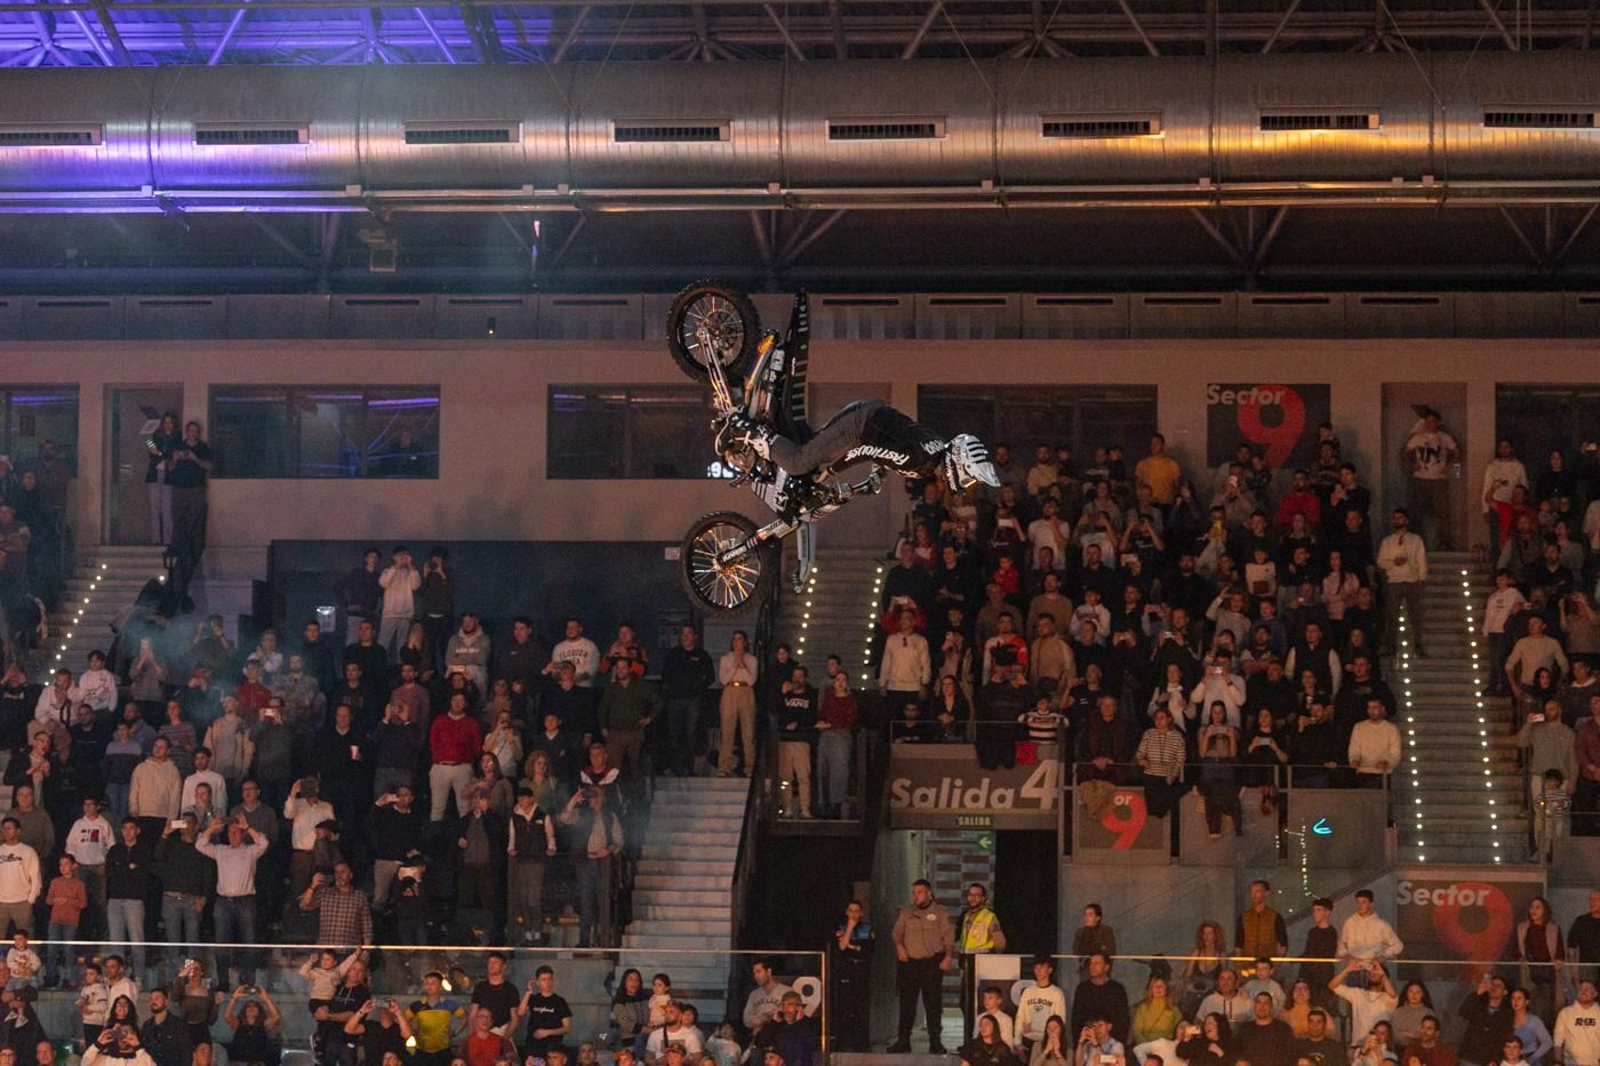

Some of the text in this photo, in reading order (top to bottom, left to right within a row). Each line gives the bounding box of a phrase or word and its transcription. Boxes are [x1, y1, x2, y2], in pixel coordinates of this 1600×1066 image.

[1207, 384, 1286, 405] Sector
[1237, 385, 1306, 469] 9
[785, 697, 810, 710] VANS
[890, 759, 1059, 810] Salida 4
[957, 816, 992, 826] SALIDA
[1101, 791, 1147, 851] 9
[1396, 881, 1490, 906] Sector
[1433, 881, 1514, 983] 9
[792, 976, 822, 1018] 9
